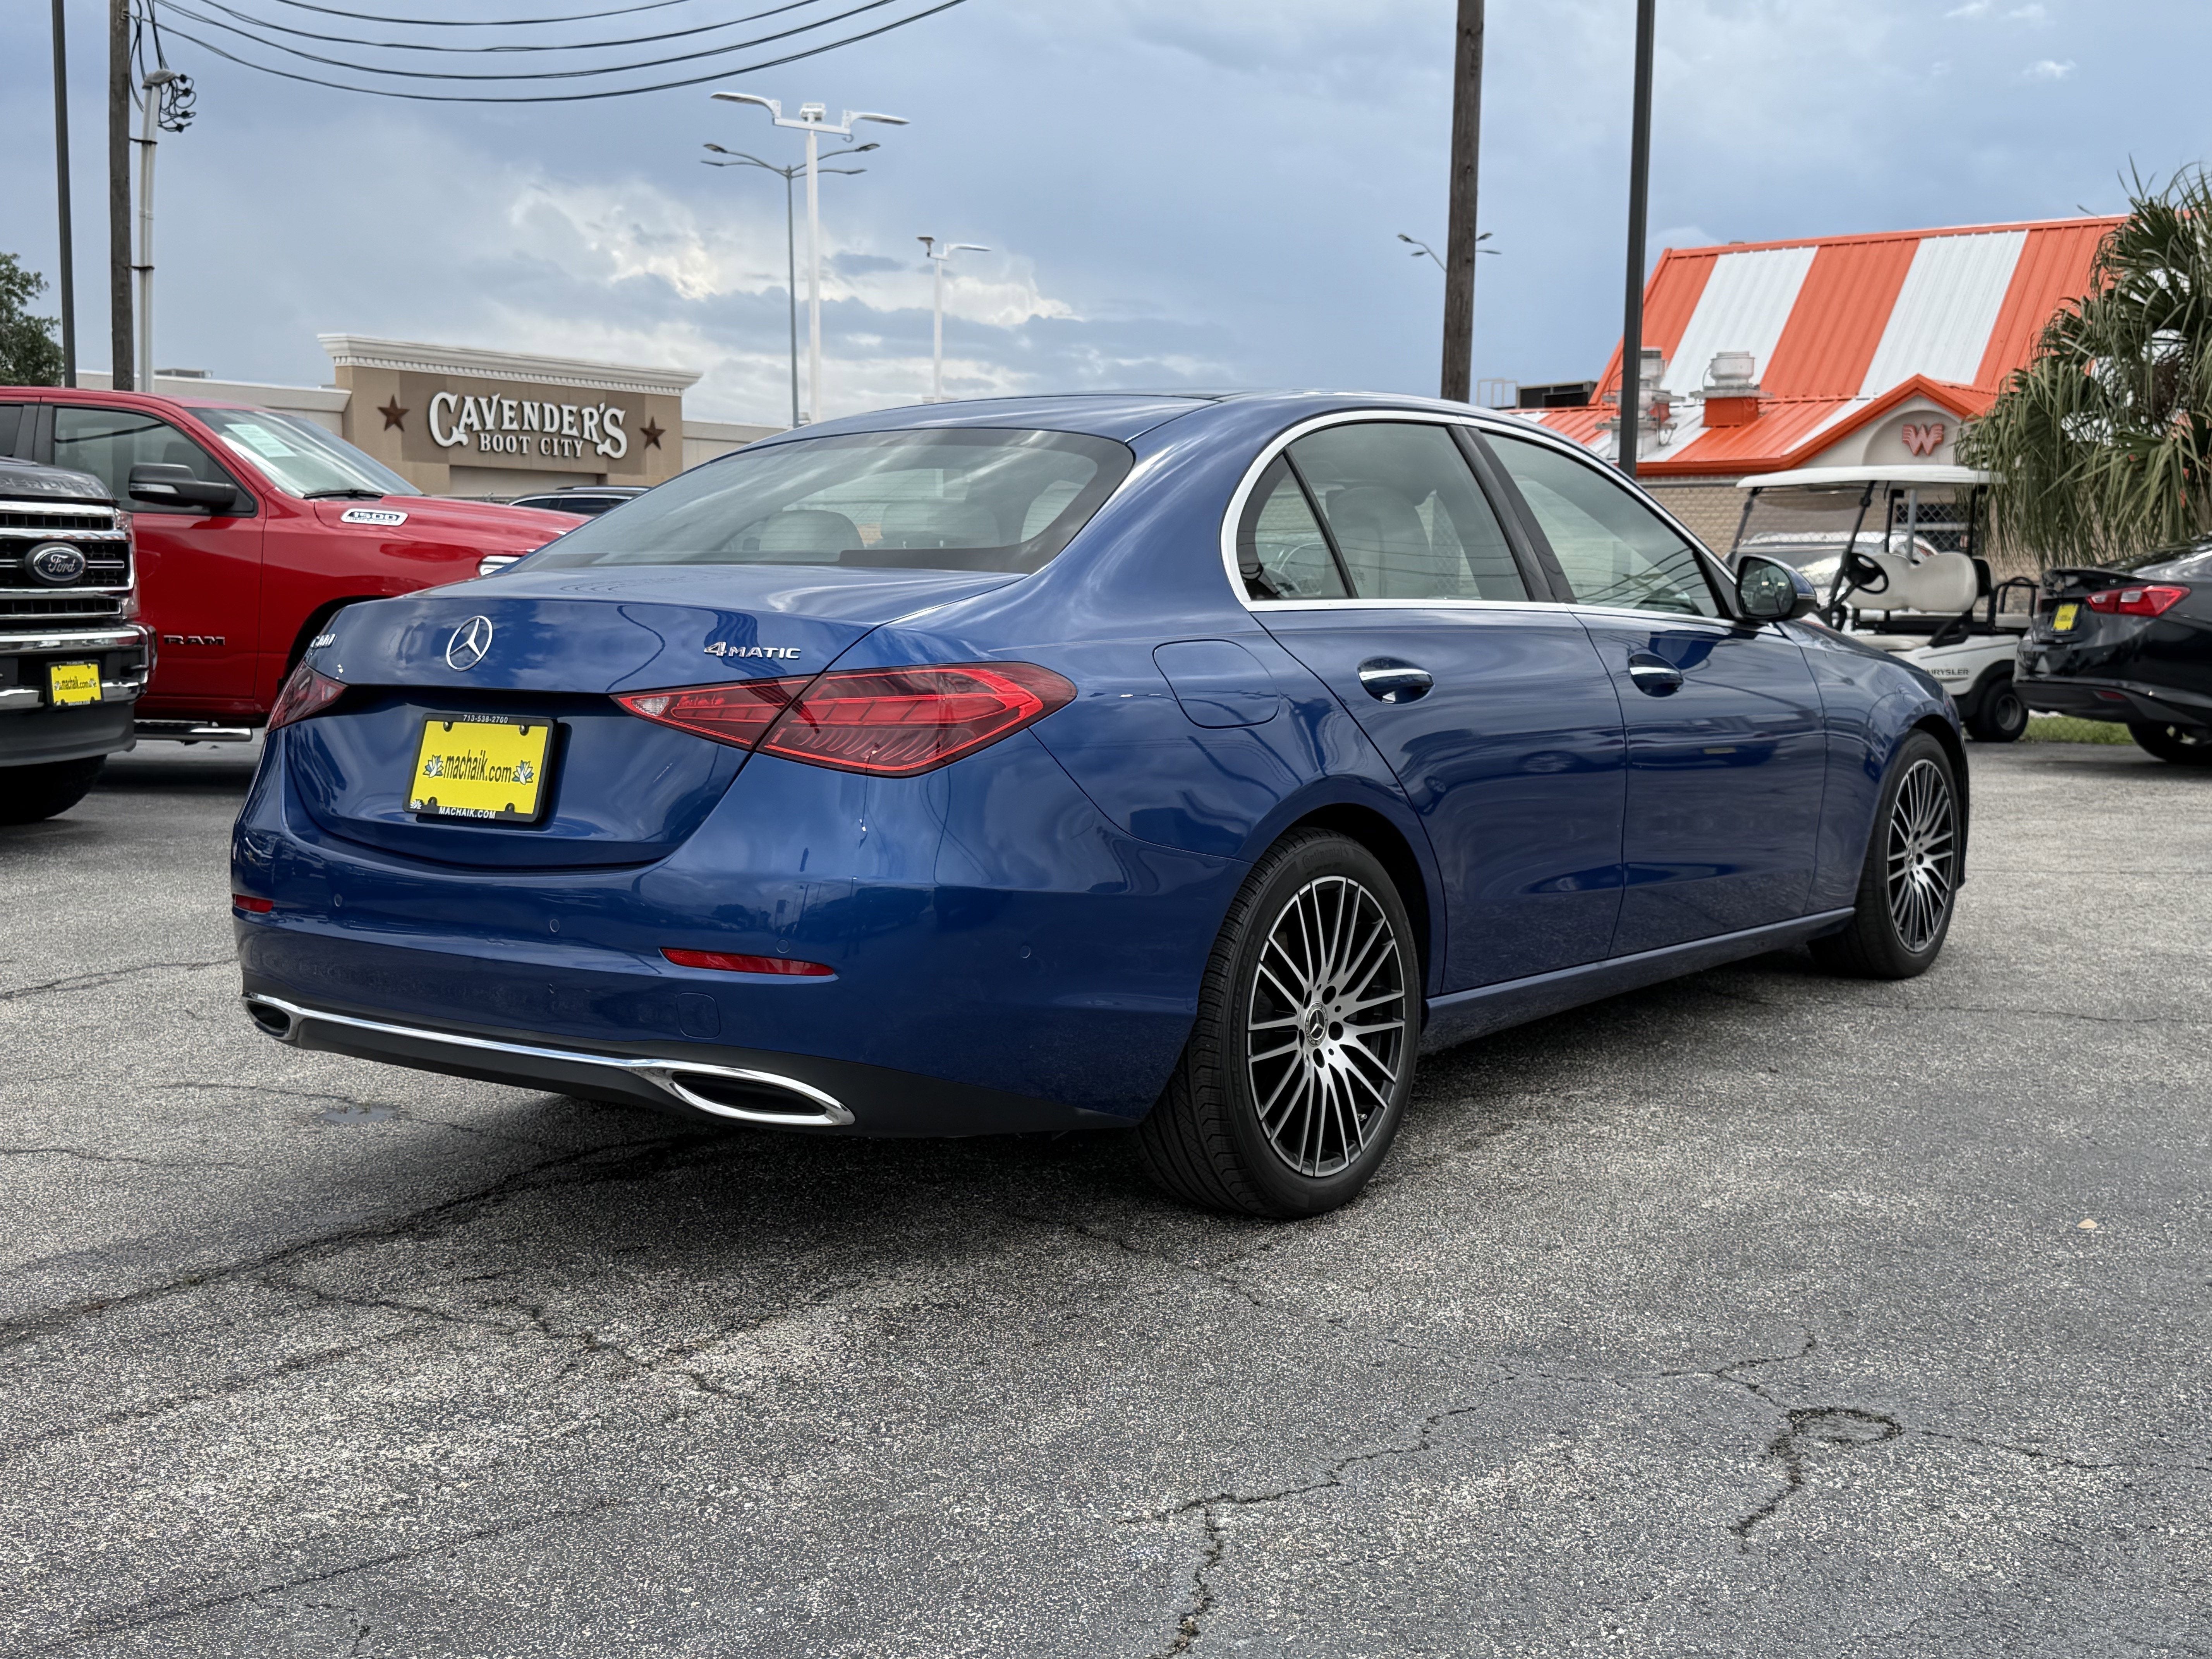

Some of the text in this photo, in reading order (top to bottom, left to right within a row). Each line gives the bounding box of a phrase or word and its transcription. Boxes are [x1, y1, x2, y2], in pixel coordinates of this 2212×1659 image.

[429, 392, 627, 459] CAVENDER'S
[479, 433, 584, 457] BOOT CITY
[1902, 423, 1944, 456] W
[354, 512, 397, 521] 1500
[48, 554, 76, 573] Ford
[163, 635, 225, 645] RAM
[704, 641, 801, 659] 4MATIC
[443, 749, 512, 783] machaik.com
[439, 806, 496, 819] MACHAIK.COM
